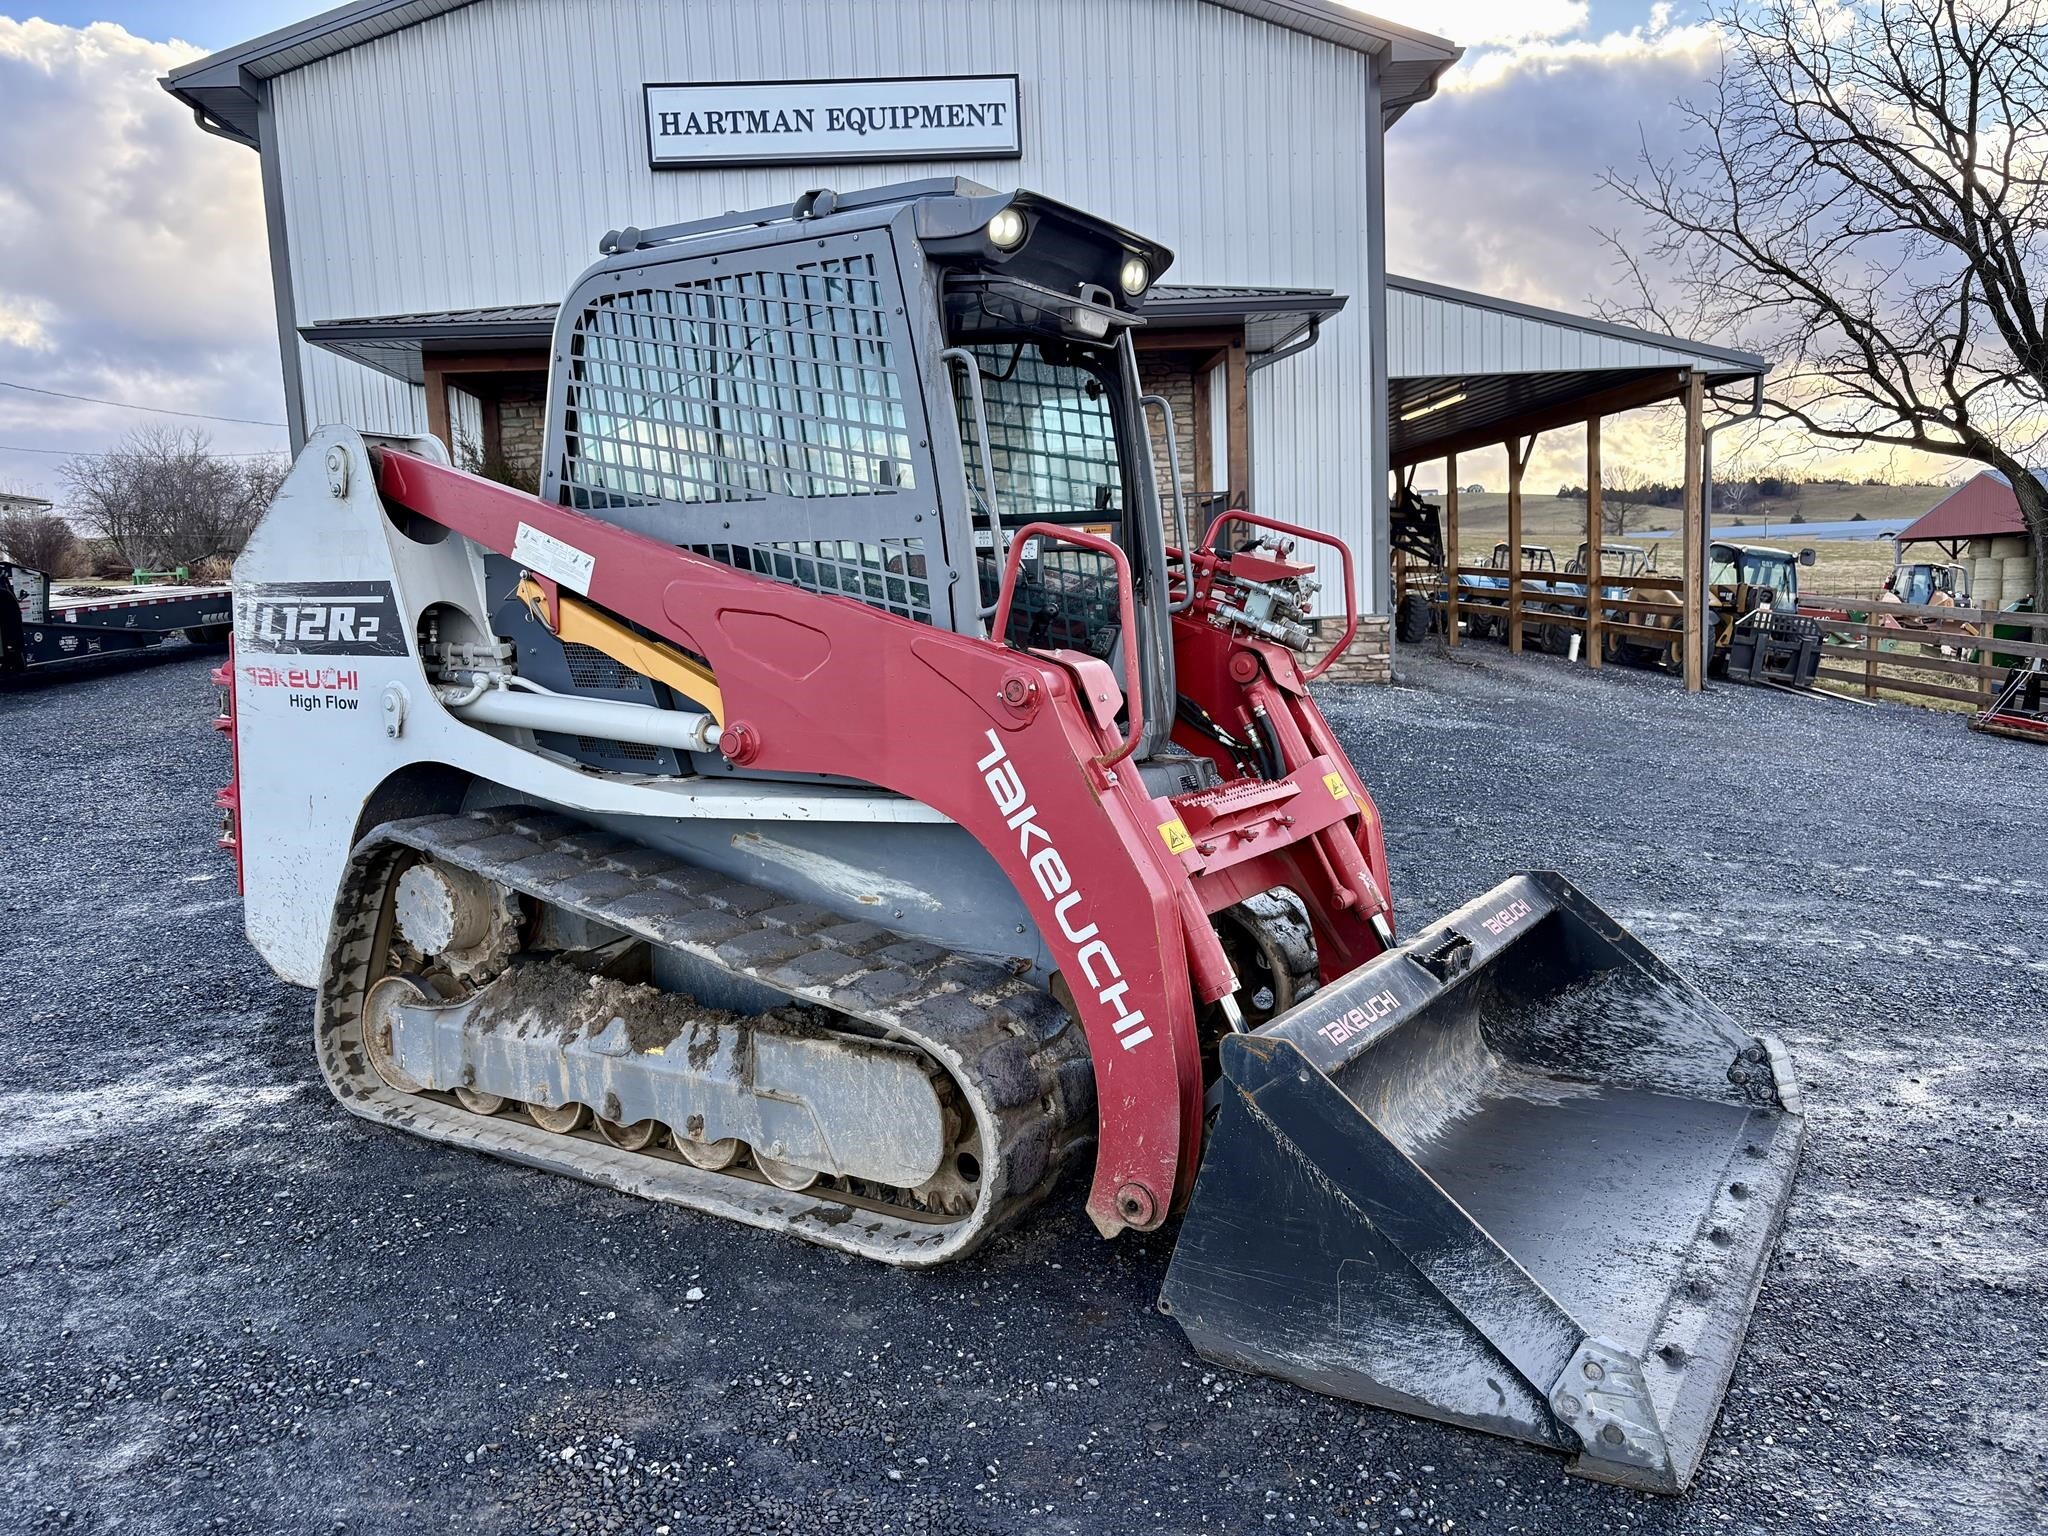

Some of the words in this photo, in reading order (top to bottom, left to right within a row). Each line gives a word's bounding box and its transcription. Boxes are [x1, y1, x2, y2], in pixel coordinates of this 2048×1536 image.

[659, 109, 815, 136] HARTMAN
[826, 102, 1007, 135] EQUIPMENT
[289, 694, 321, 711] High
[325, 695, 358, 710] Flow
